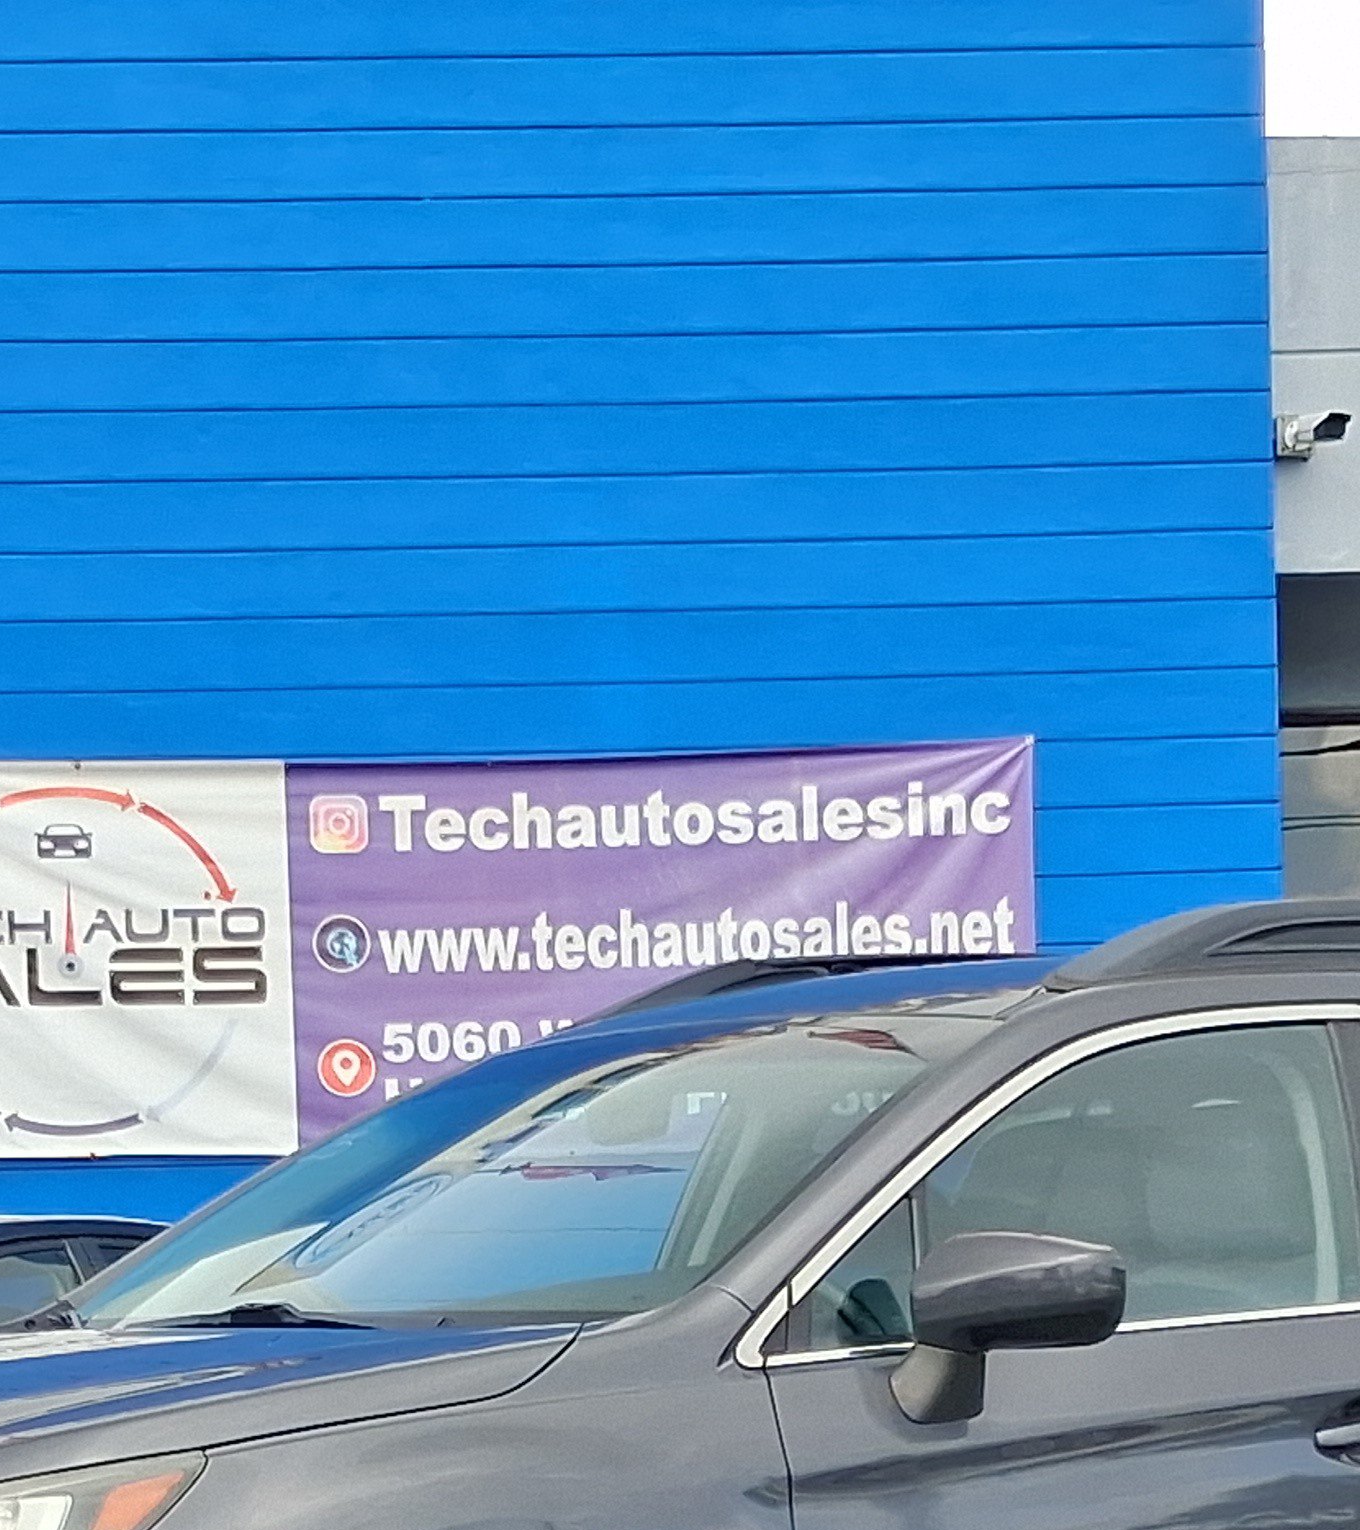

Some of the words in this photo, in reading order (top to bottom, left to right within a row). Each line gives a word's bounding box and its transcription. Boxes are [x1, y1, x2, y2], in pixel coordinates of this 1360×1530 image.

[378, 781, 1011, 852] Techautosalesinc
[82, 906, 266, 944] AUTO
[378, 896, 1015, 973] www.techautosales.net
[383, 1020, 522, 1063] 5060
